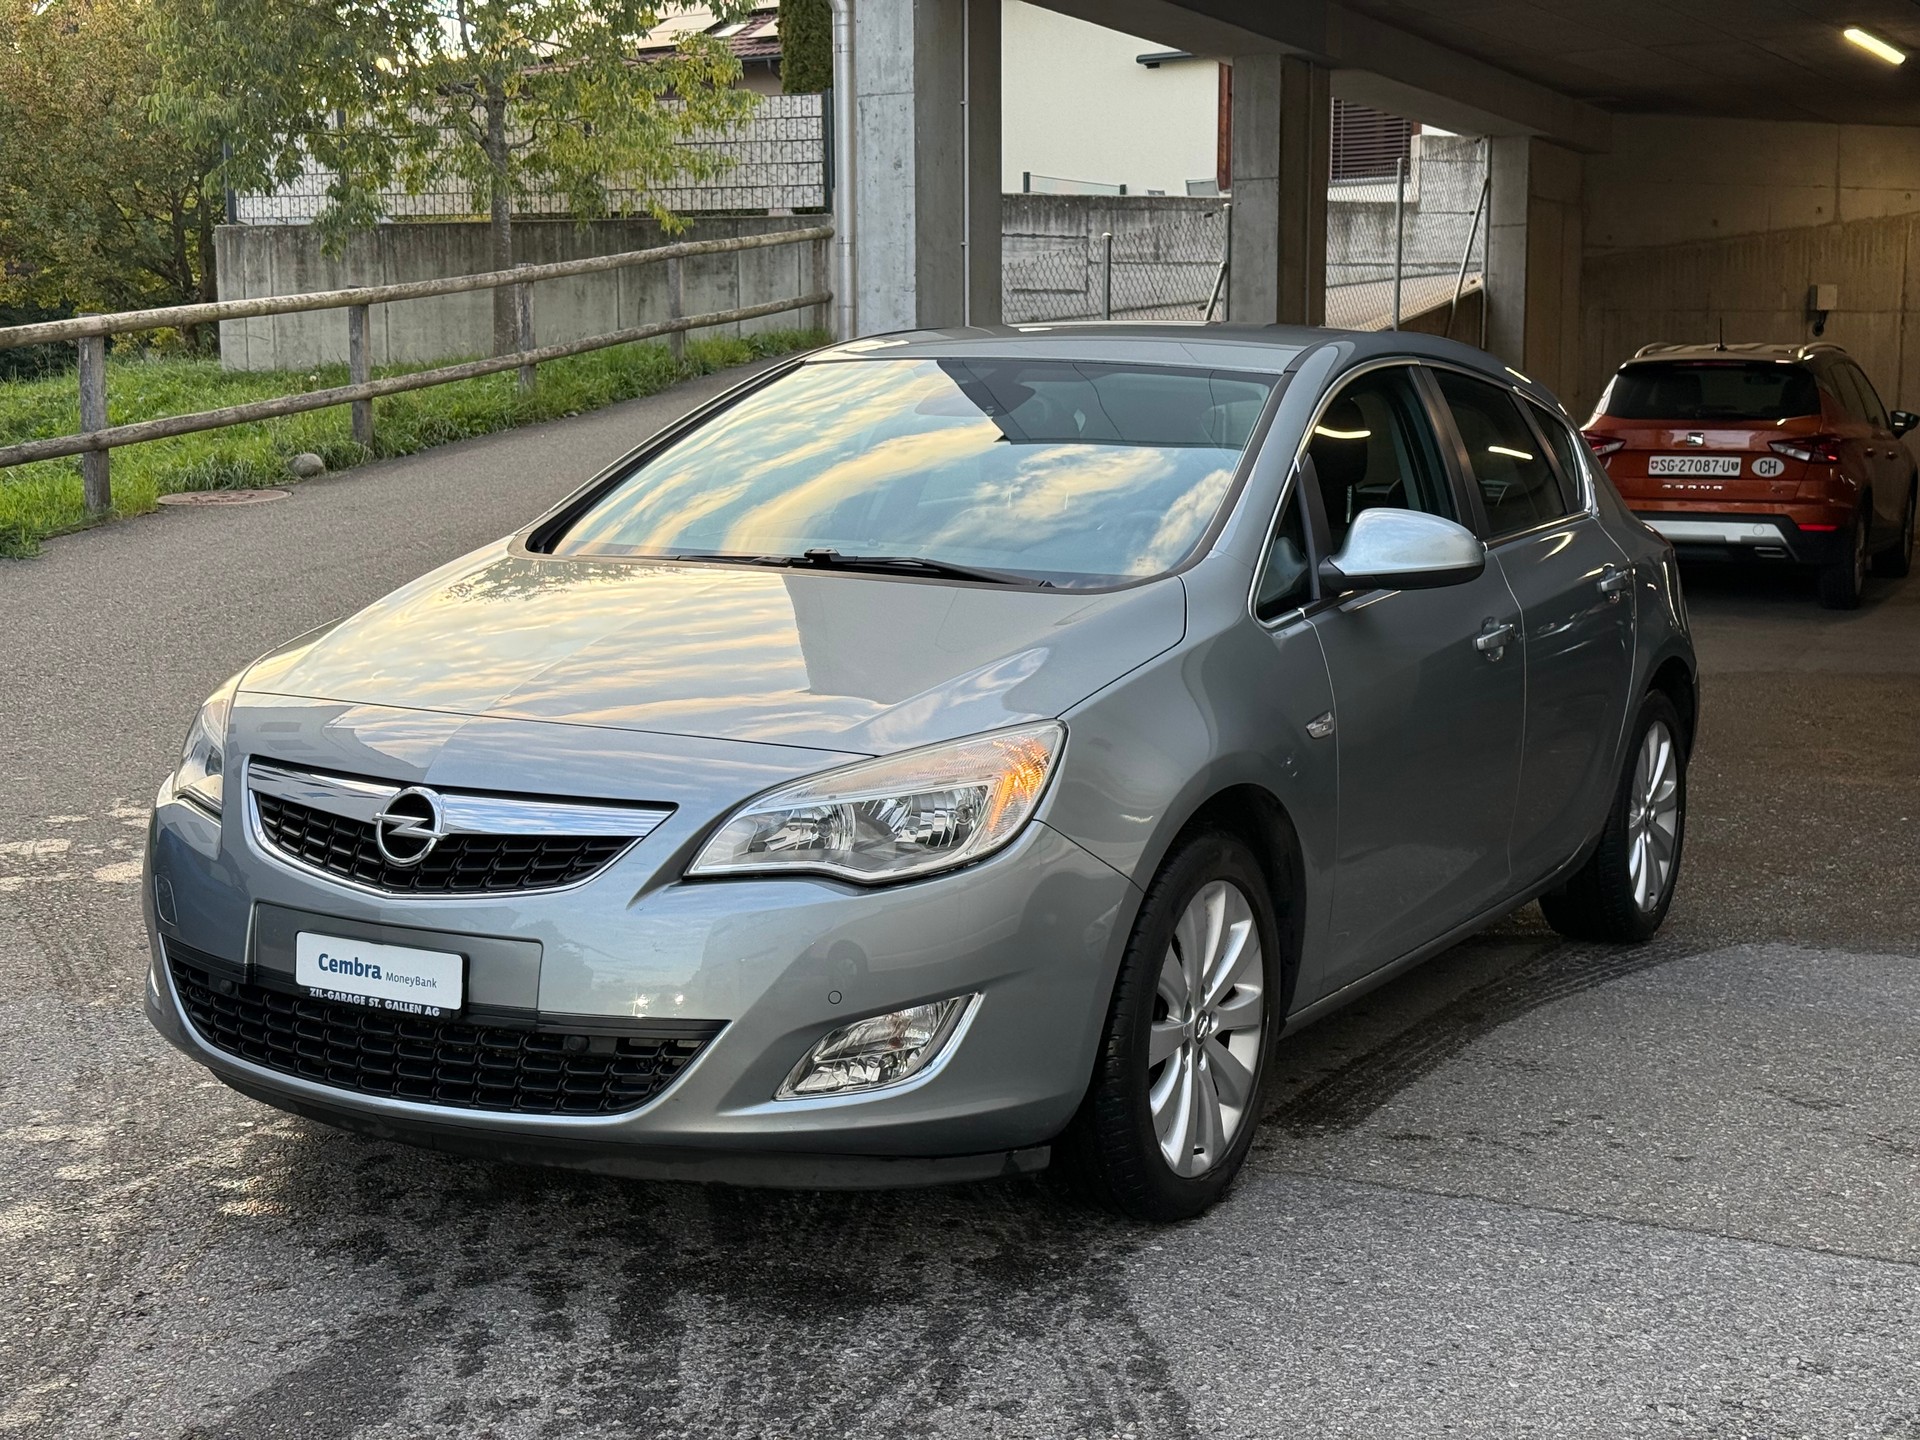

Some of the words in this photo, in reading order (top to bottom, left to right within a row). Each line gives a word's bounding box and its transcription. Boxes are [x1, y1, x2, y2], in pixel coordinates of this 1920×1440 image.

[1759, 460, 1777, 475] CH
[318, 953, 382, 980] Cembra
[385, 972, 437, 989] MoneyBank
[309, 987, 366, 1006] ZIL-GARAGE
[368, 997, 382, 1009] ST.
[384, 1000, 422, 1015] GALLEN
[424, 1006, 441, 1017] AG
